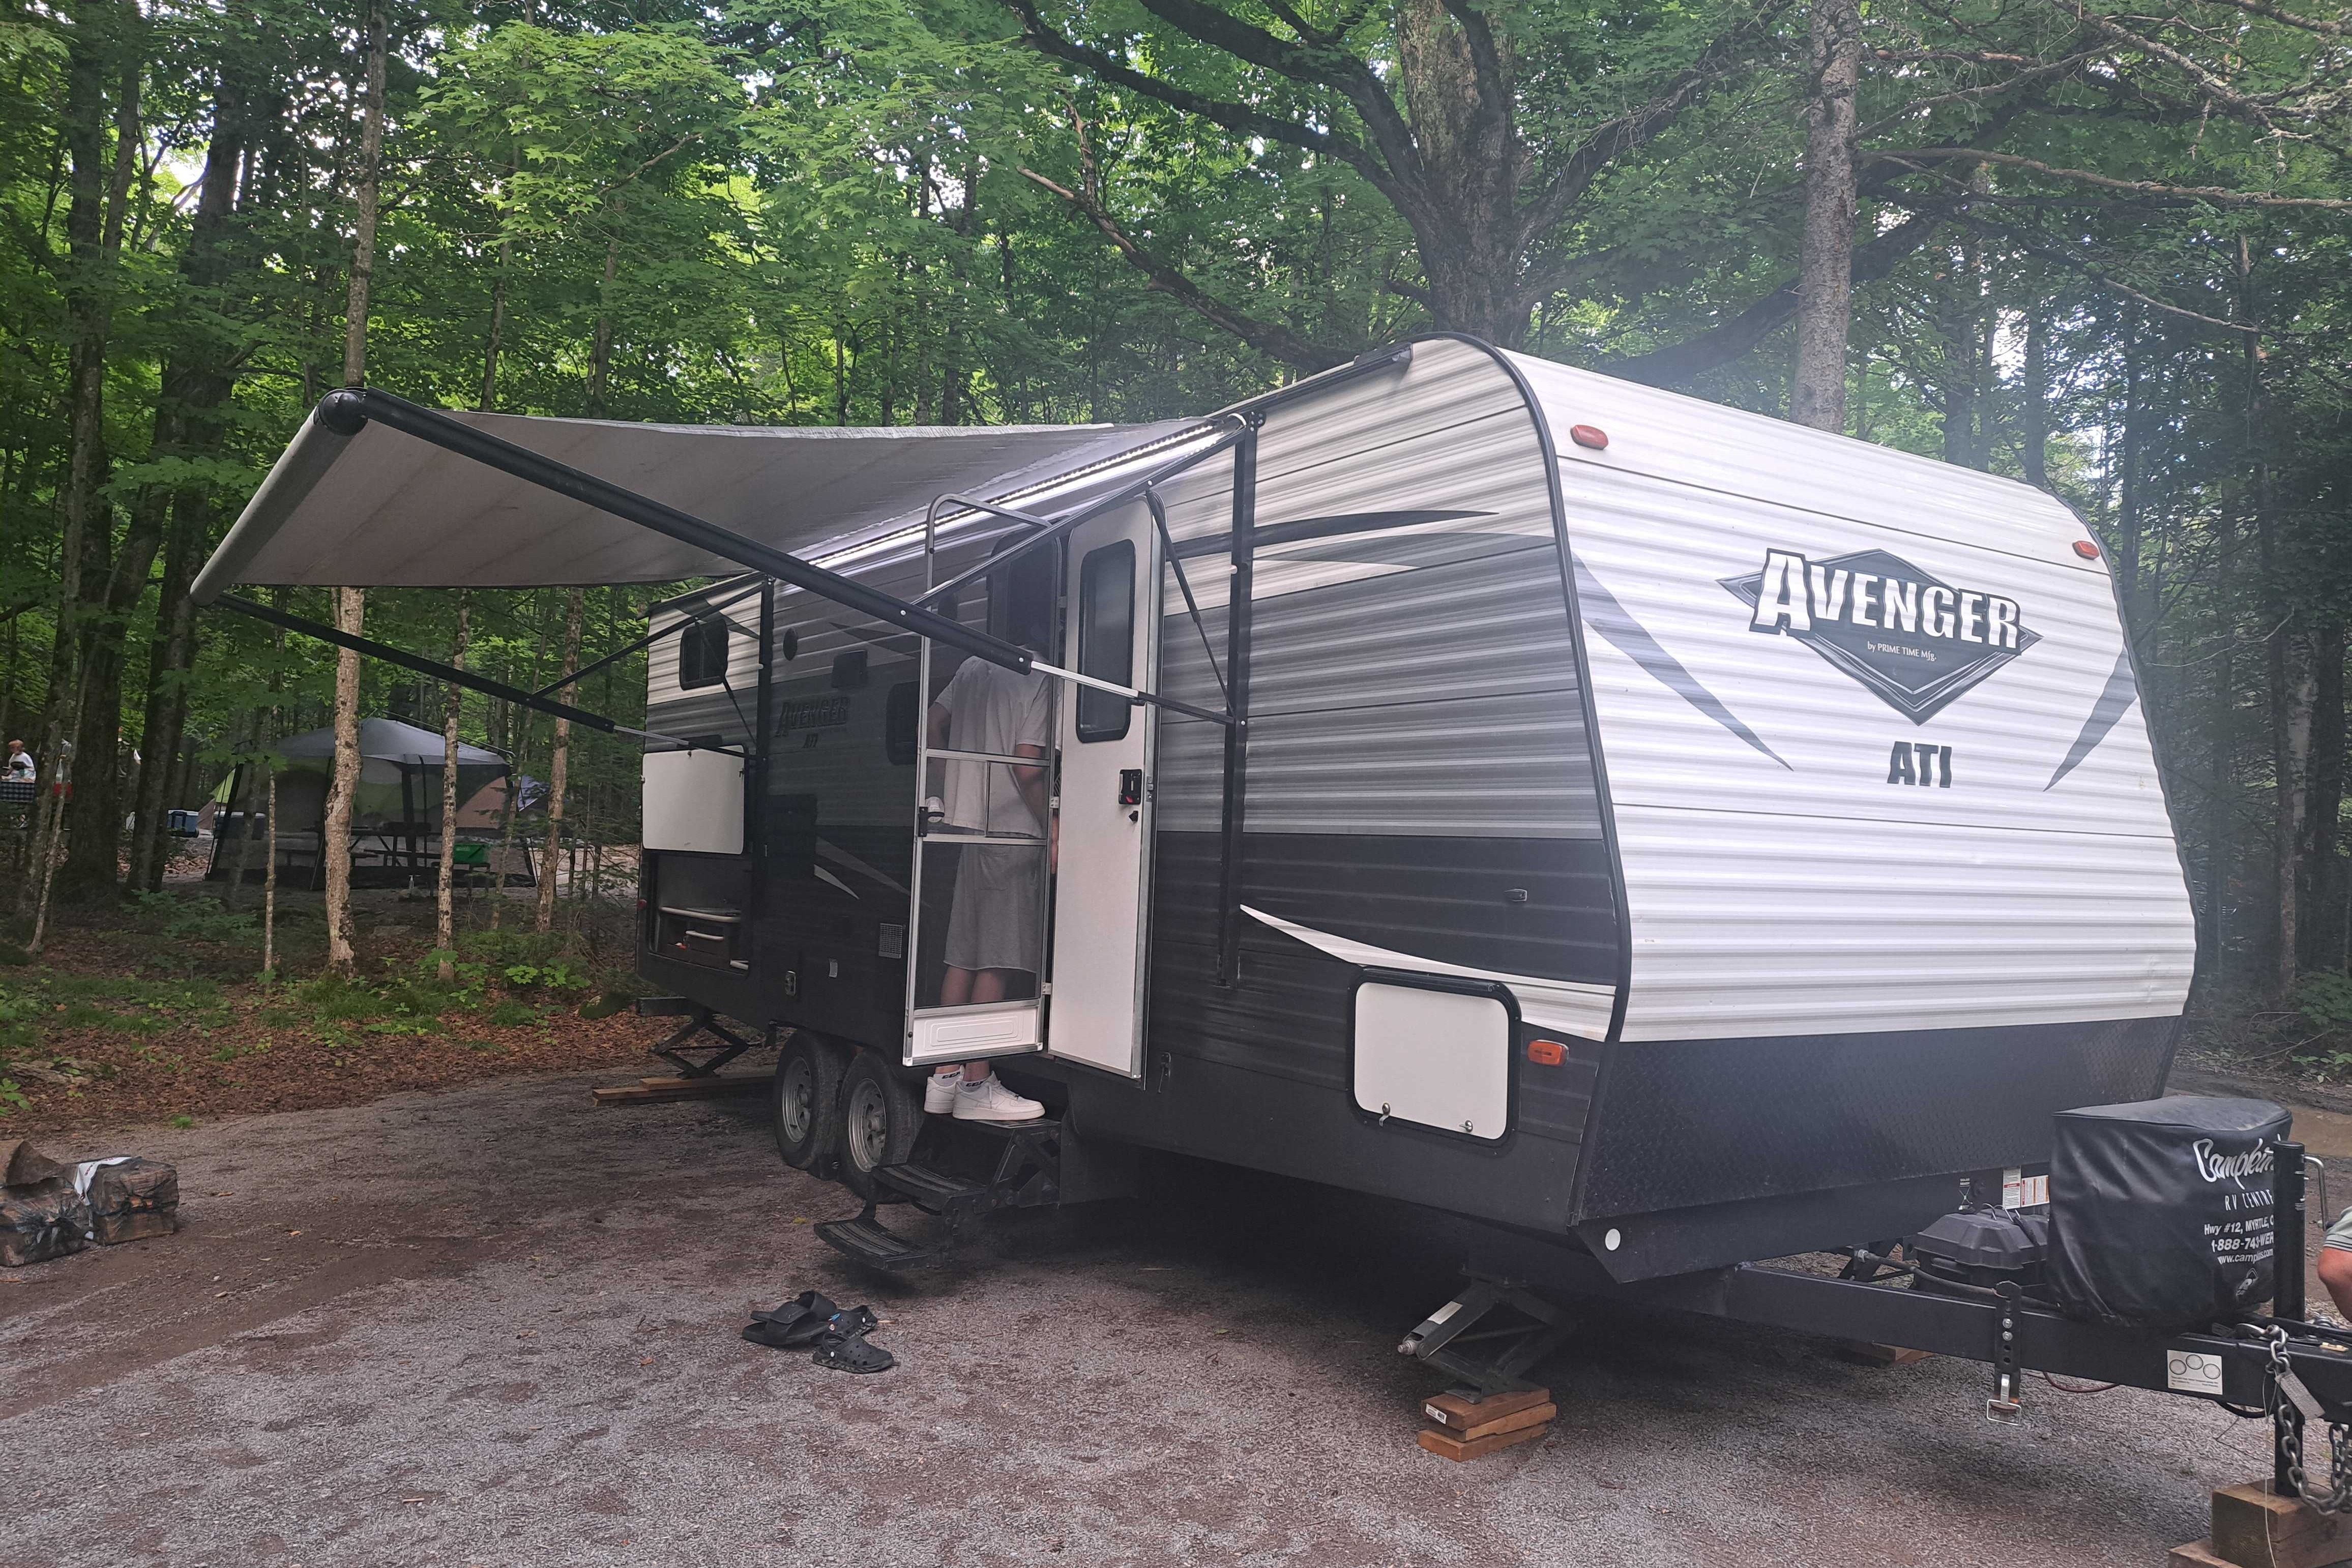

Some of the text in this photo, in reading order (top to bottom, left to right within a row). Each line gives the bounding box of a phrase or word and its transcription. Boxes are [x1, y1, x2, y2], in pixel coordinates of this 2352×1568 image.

[1750, 549, 2020, 654] AVENGER
[1867, 641, 1936, 662] by PRIME TIME Mfg.
[1887, 741, 1952, 788] ATI
[2204, 1224, 2222, 1235] Hwy
[2224, 1222, 2243, 1234] #12,
[2246, 1216, 2269, 1232] MYRTLE,
